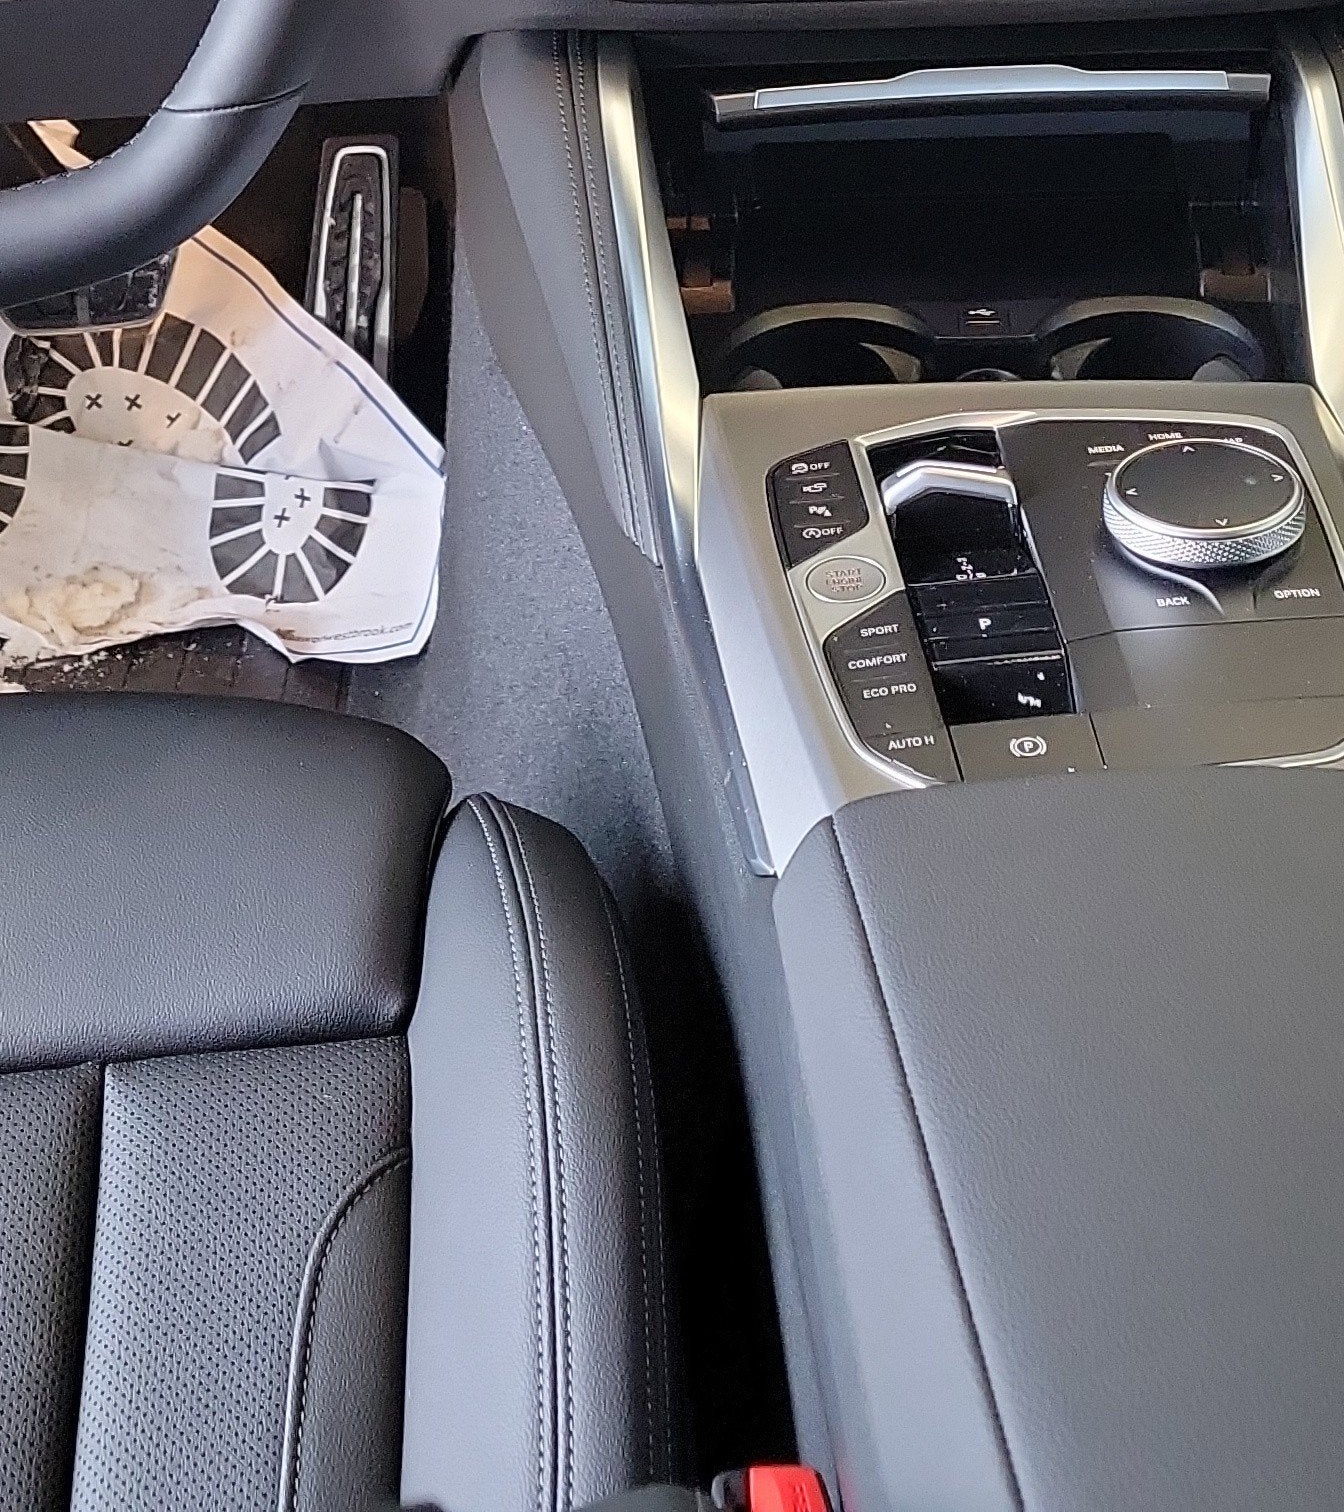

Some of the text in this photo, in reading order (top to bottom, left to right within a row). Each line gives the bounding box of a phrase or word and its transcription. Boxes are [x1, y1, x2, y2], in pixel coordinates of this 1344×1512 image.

[1147, 432, 1183, 441] HOME
[1087, 444, 1124, 455] MEDIA
[810, 462, 831, 471] OFF
[821, 527, 843, 536] OFF
[1273, 588, 1321, 600] OPTION
[1156, 596, 1191, 607] BACK
[860, 623, 899, 638] SPORT
[978, 618, 992, 631] P
[848, 653, 908, 670] COMFORT
[862, 683, 917, 699] ECO PRO
[888, 735, 935, 750] AUTO H
